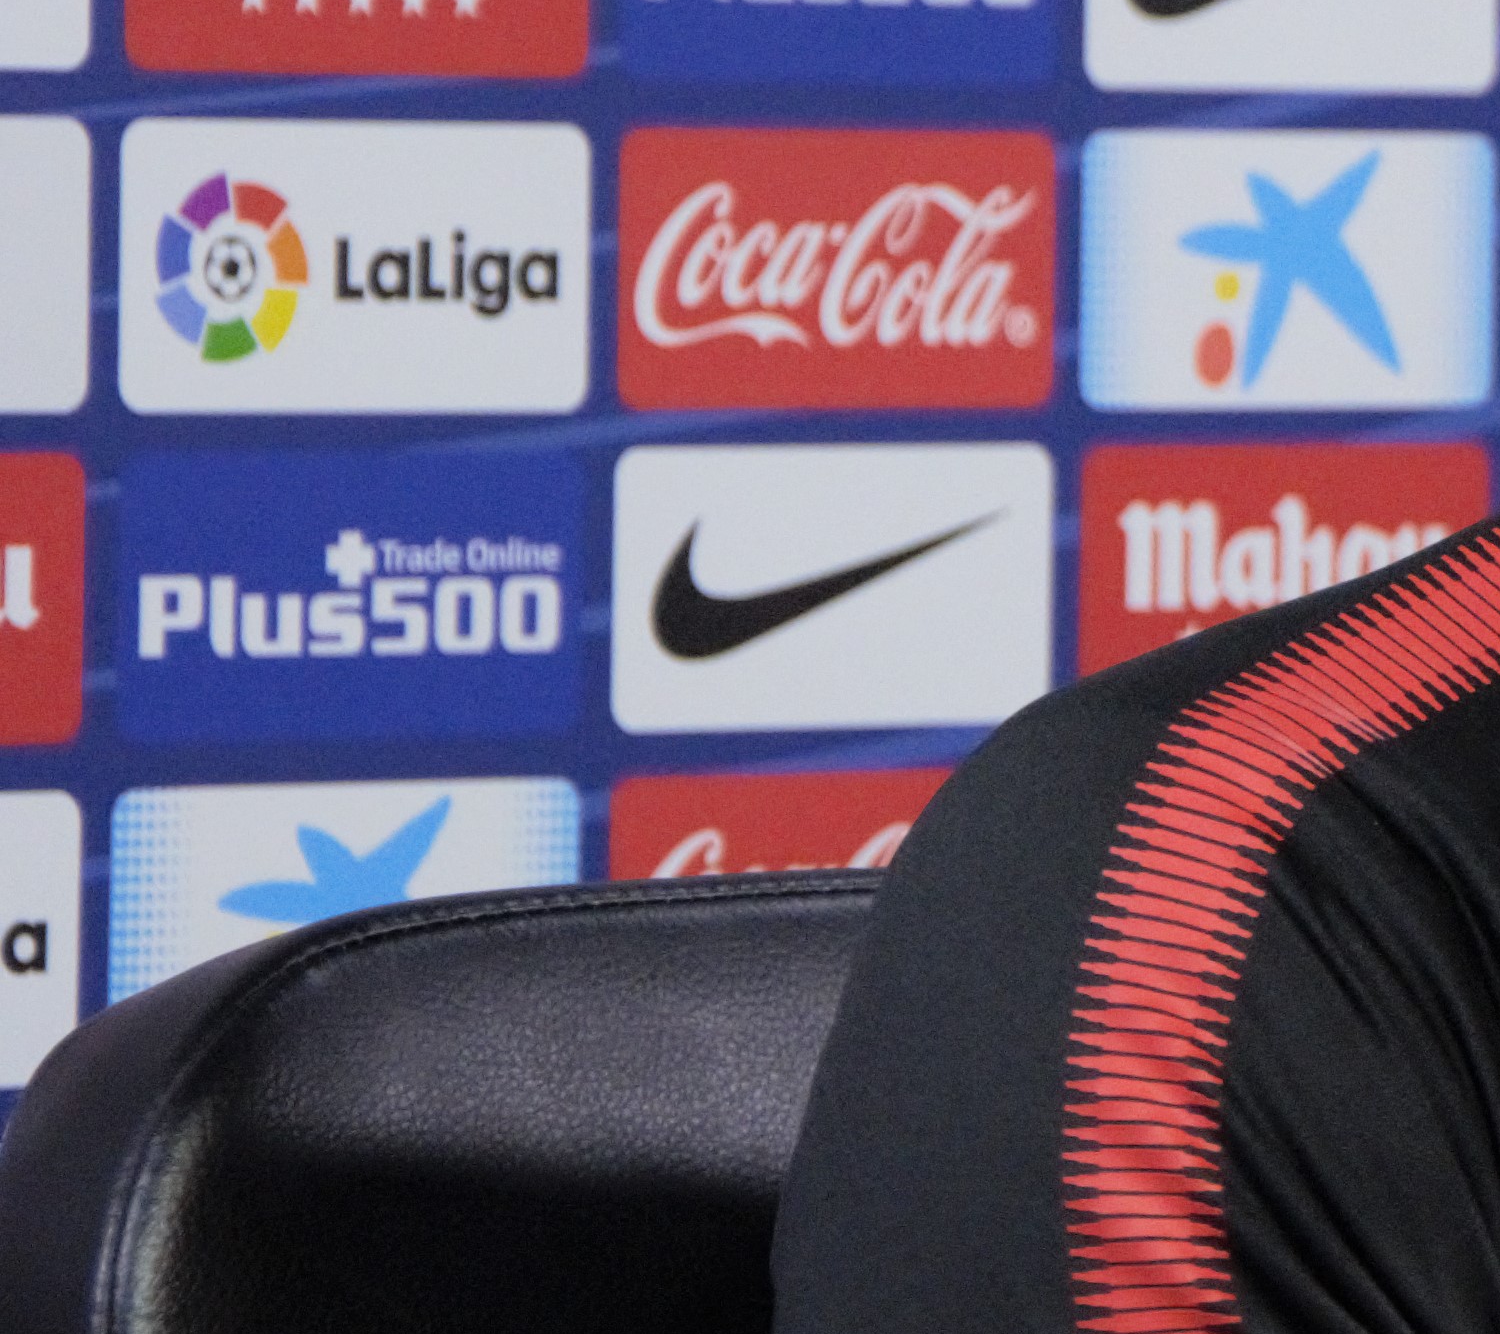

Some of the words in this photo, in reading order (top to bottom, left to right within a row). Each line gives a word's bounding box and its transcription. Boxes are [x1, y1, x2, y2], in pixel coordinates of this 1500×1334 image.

[336, 231, 558, 318] LaLiga
[634, 183, 1036, 346] Coca-Cola
[378, 539, 461, 572] Trade
[468, 538, 560, 571] Online
[1119, 495, 1452, 611] Maho
[139, 573, 562, 658] Plus500
